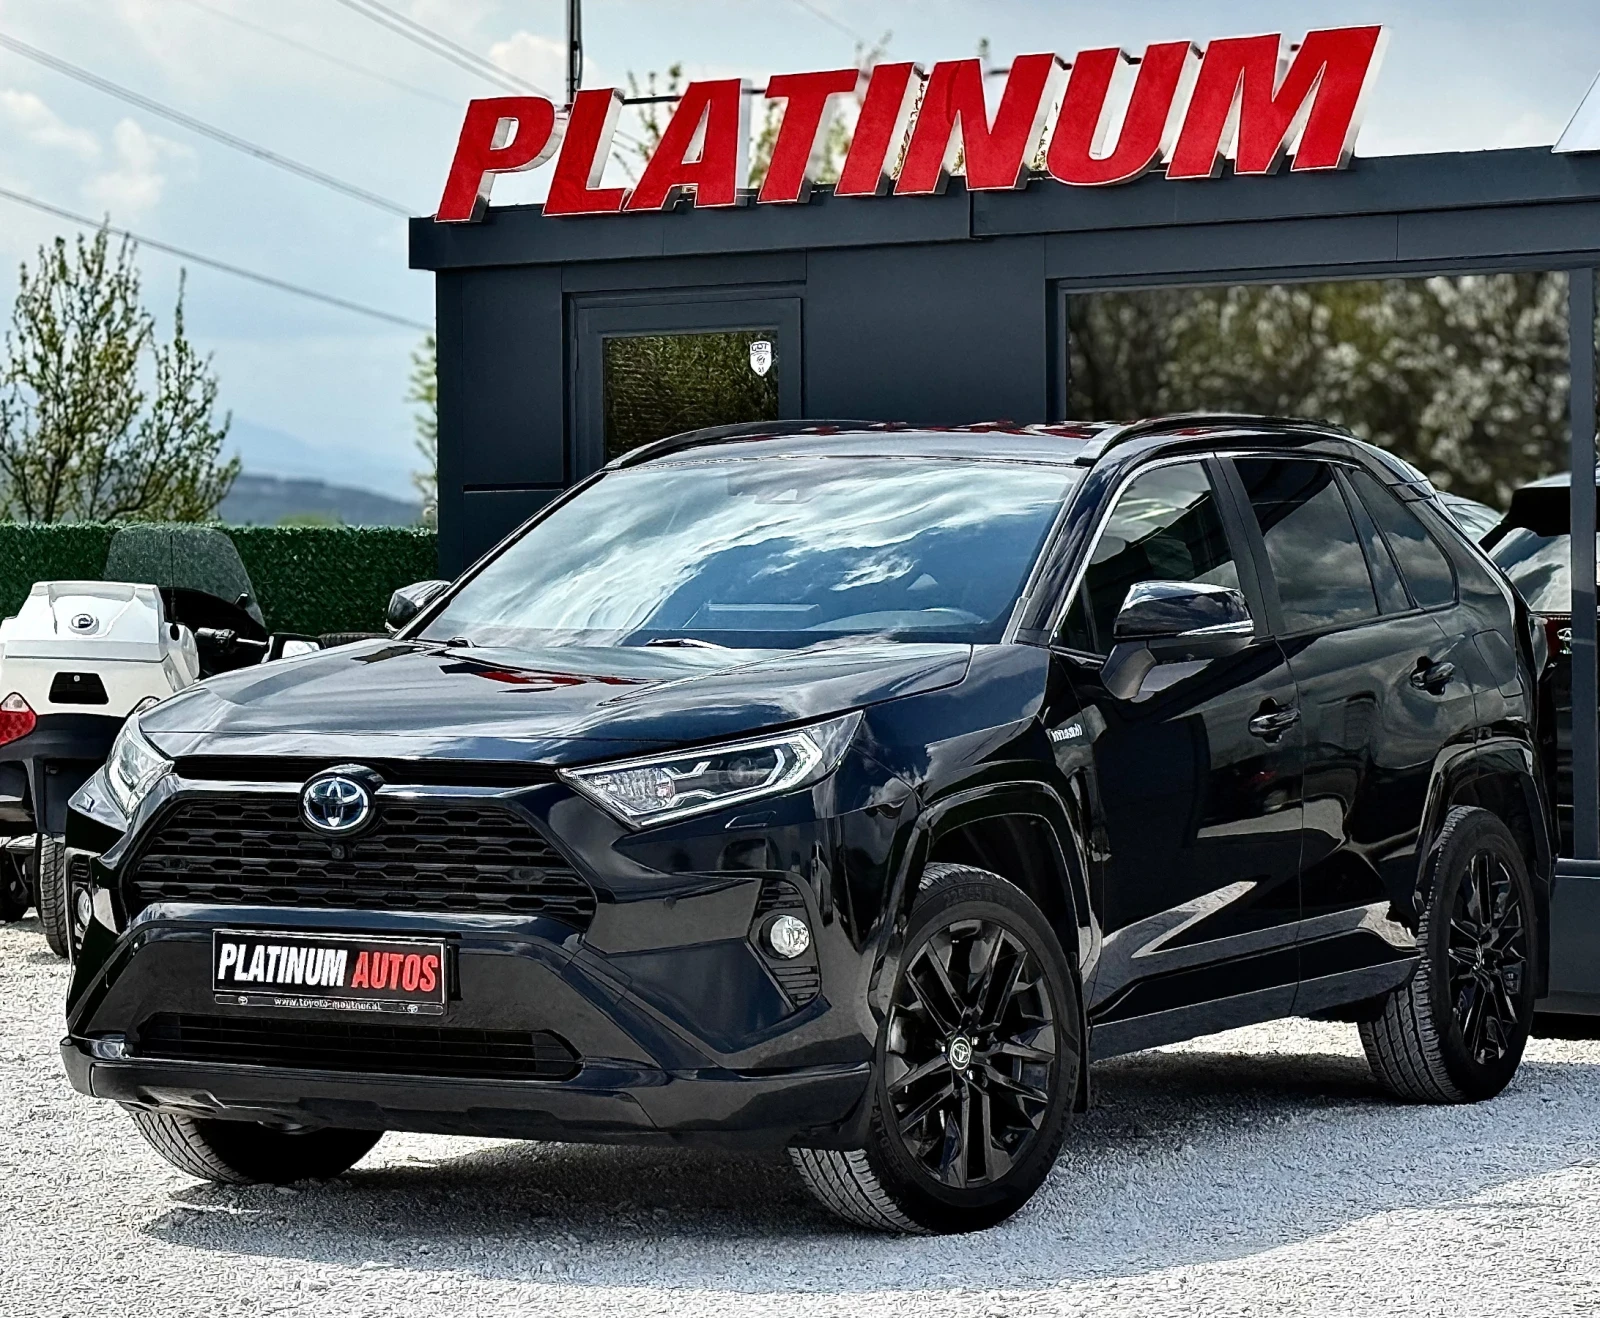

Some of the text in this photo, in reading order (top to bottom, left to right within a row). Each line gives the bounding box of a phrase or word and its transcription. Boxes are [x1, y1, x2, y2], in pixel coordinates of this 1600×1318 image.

[434, 25, 1385, 224] PLATINUM
[218, 943, 438, 992] PLATINUM AUTOS
